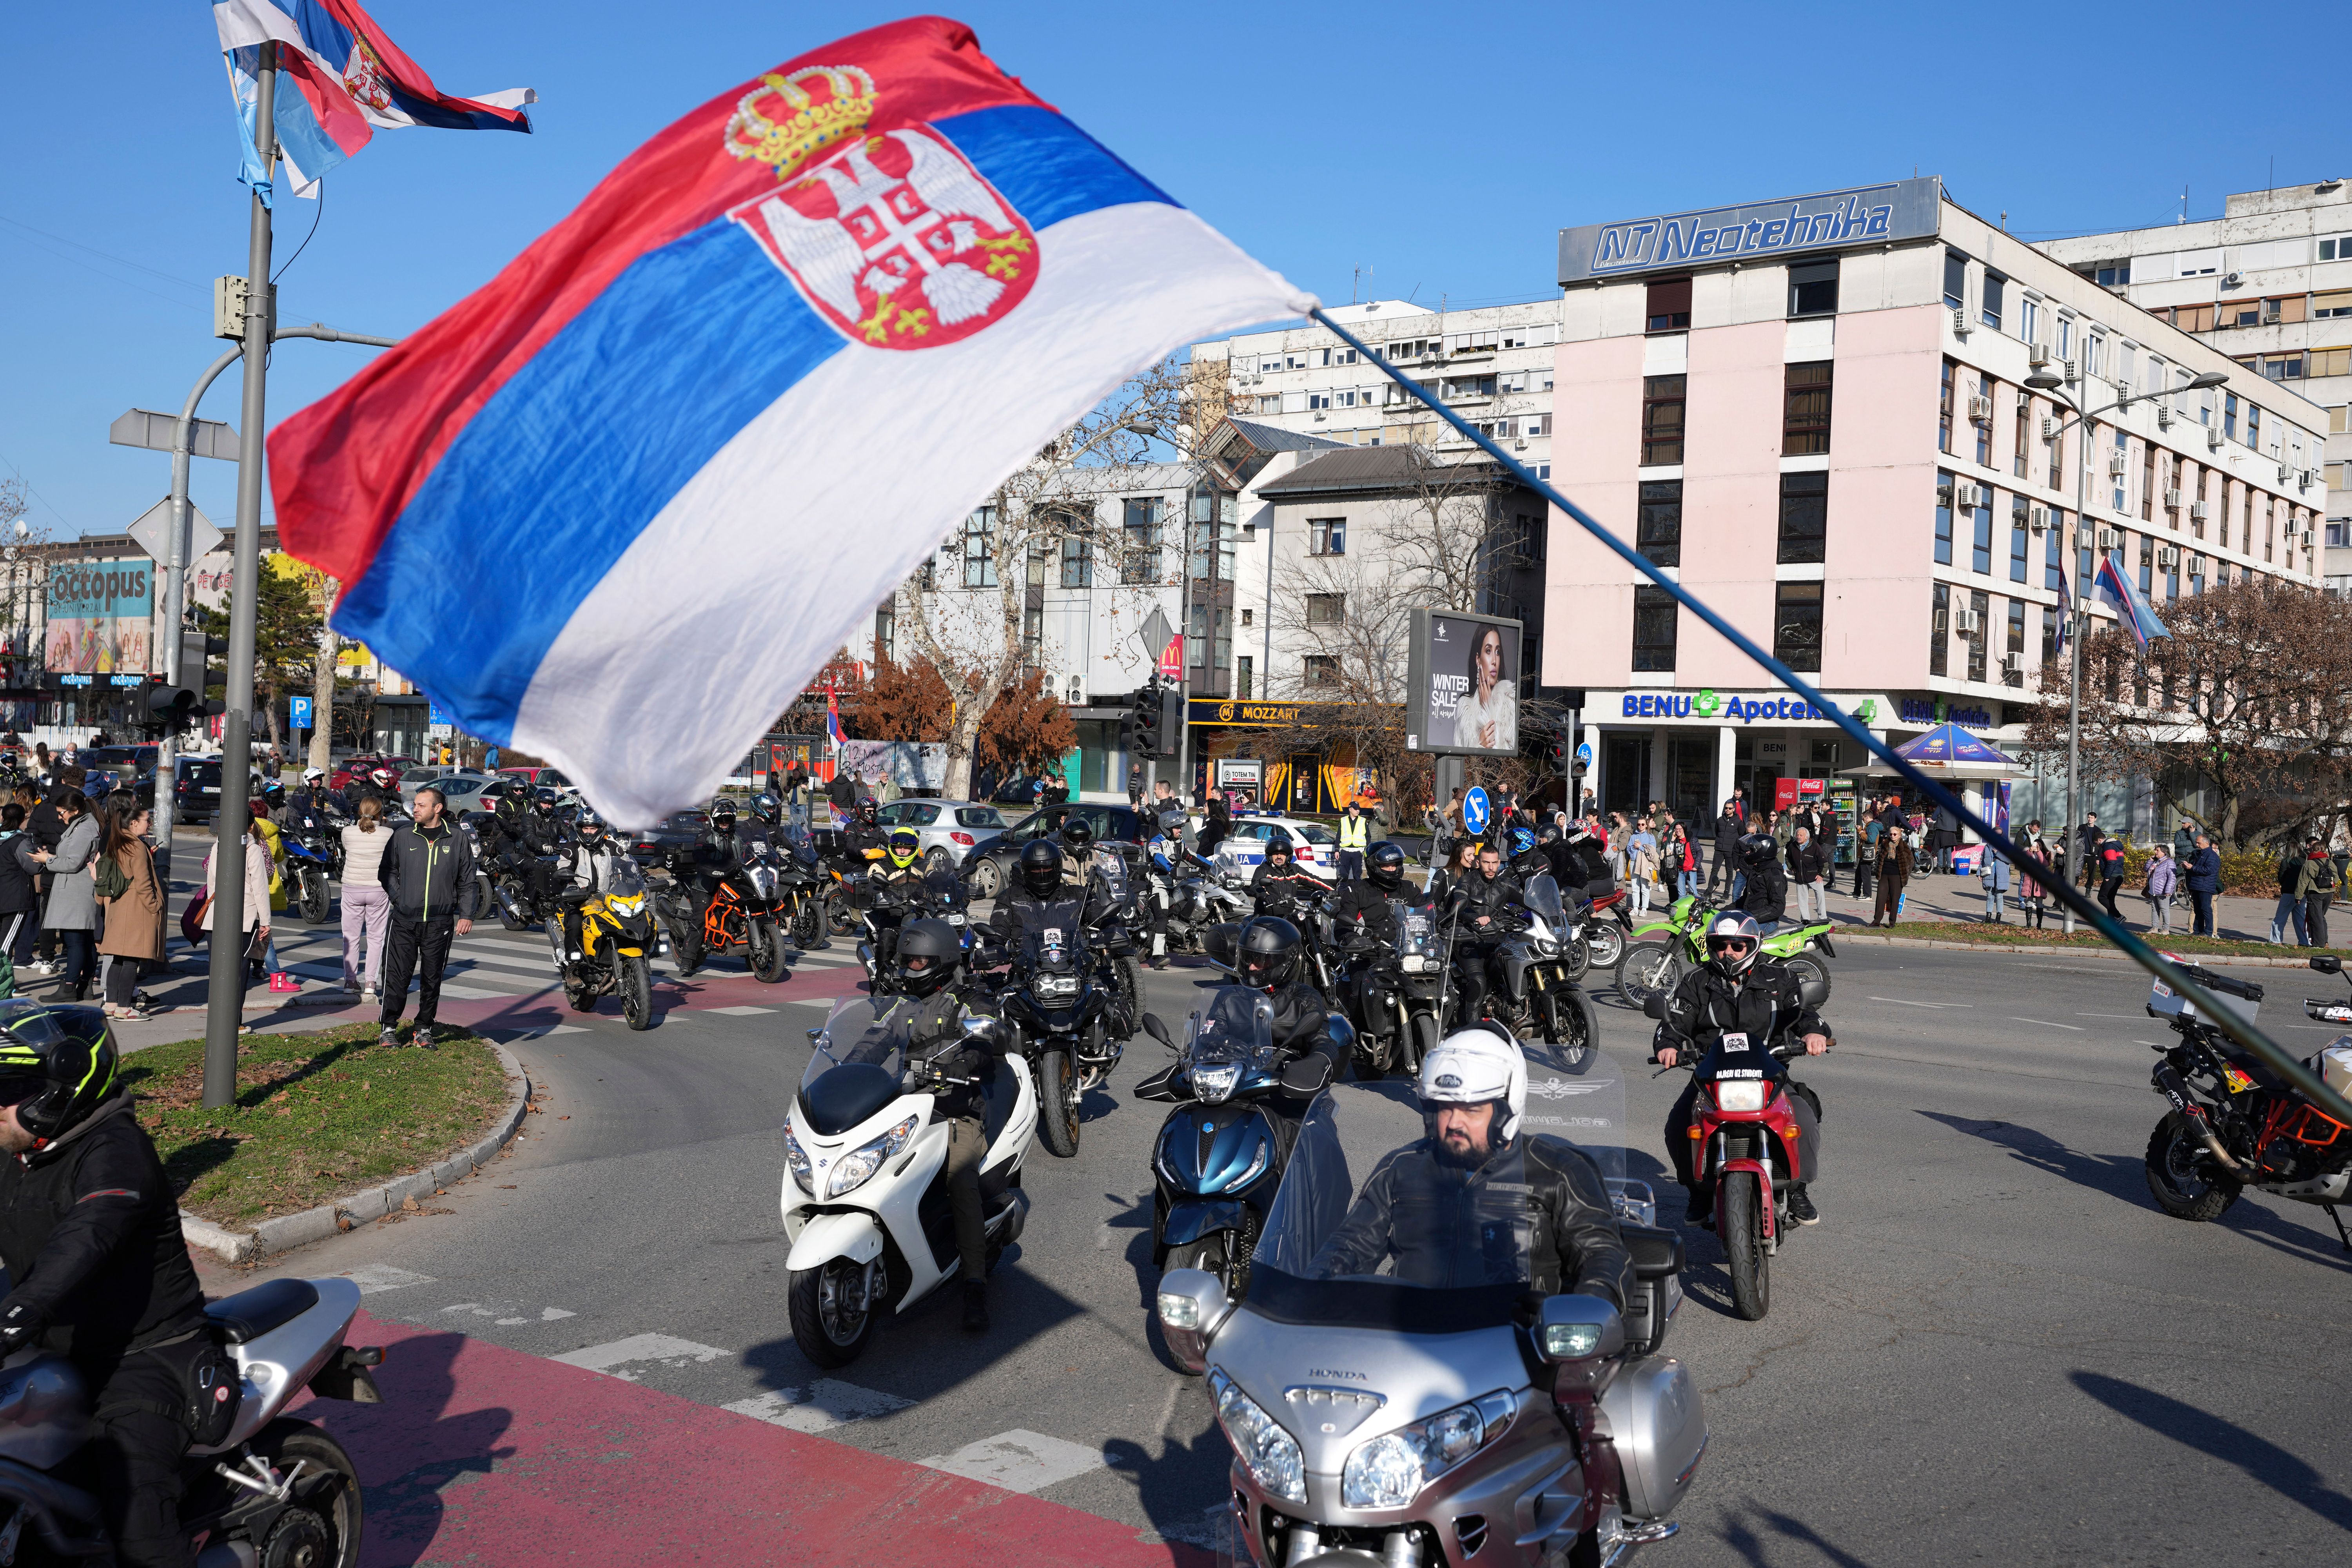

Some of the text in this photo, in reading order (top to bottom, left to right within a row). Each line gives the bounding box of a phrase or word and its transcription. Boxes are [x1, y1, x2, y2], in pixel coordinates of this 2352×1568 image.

[1657, 195, 1892, 262] Neotehnika
[1602, 224, 1655, 261] NT
[1600, 258, 1641, 267] Neotehnika
[198, 573, 233, 589] PET CEN
[54, 570, 145, 612] octopus
[65, 603, 102, 612] UNIVERZAL
[61, 673, 93, 689] octopus
[1433, 673, 1469, 691] WINTER
[1432, 690, 1457, 707] SALE
[296, 700, 307, 714] P
[1623, 695, 1691, 717] BENU
[1243, 707, 1300, 720] MOZZART
[1440, 707, 1456, 720] around
[1902, 699, 1991, 728] BENU Apoteka
[857, 761, 885, 775] MOSTA
[1802, 780, 1821, 789] Coca-Cola
[1517, 864, 1529, 872] LS2
[1787, 936, 1801, 949] 46
[2325, 1007, 2352, 1018] KTM
[1437, 1076, 1461, 1086] Airoh
[1716, 1069, 1763, 1079] BAJKERI UZ STUDENTE
[2166, 1090, 2184, 1111] KTM
[1013, 1122, 1031, 1147] BURGMAN
[1309, 1368, 1368, 1380] HONDA
